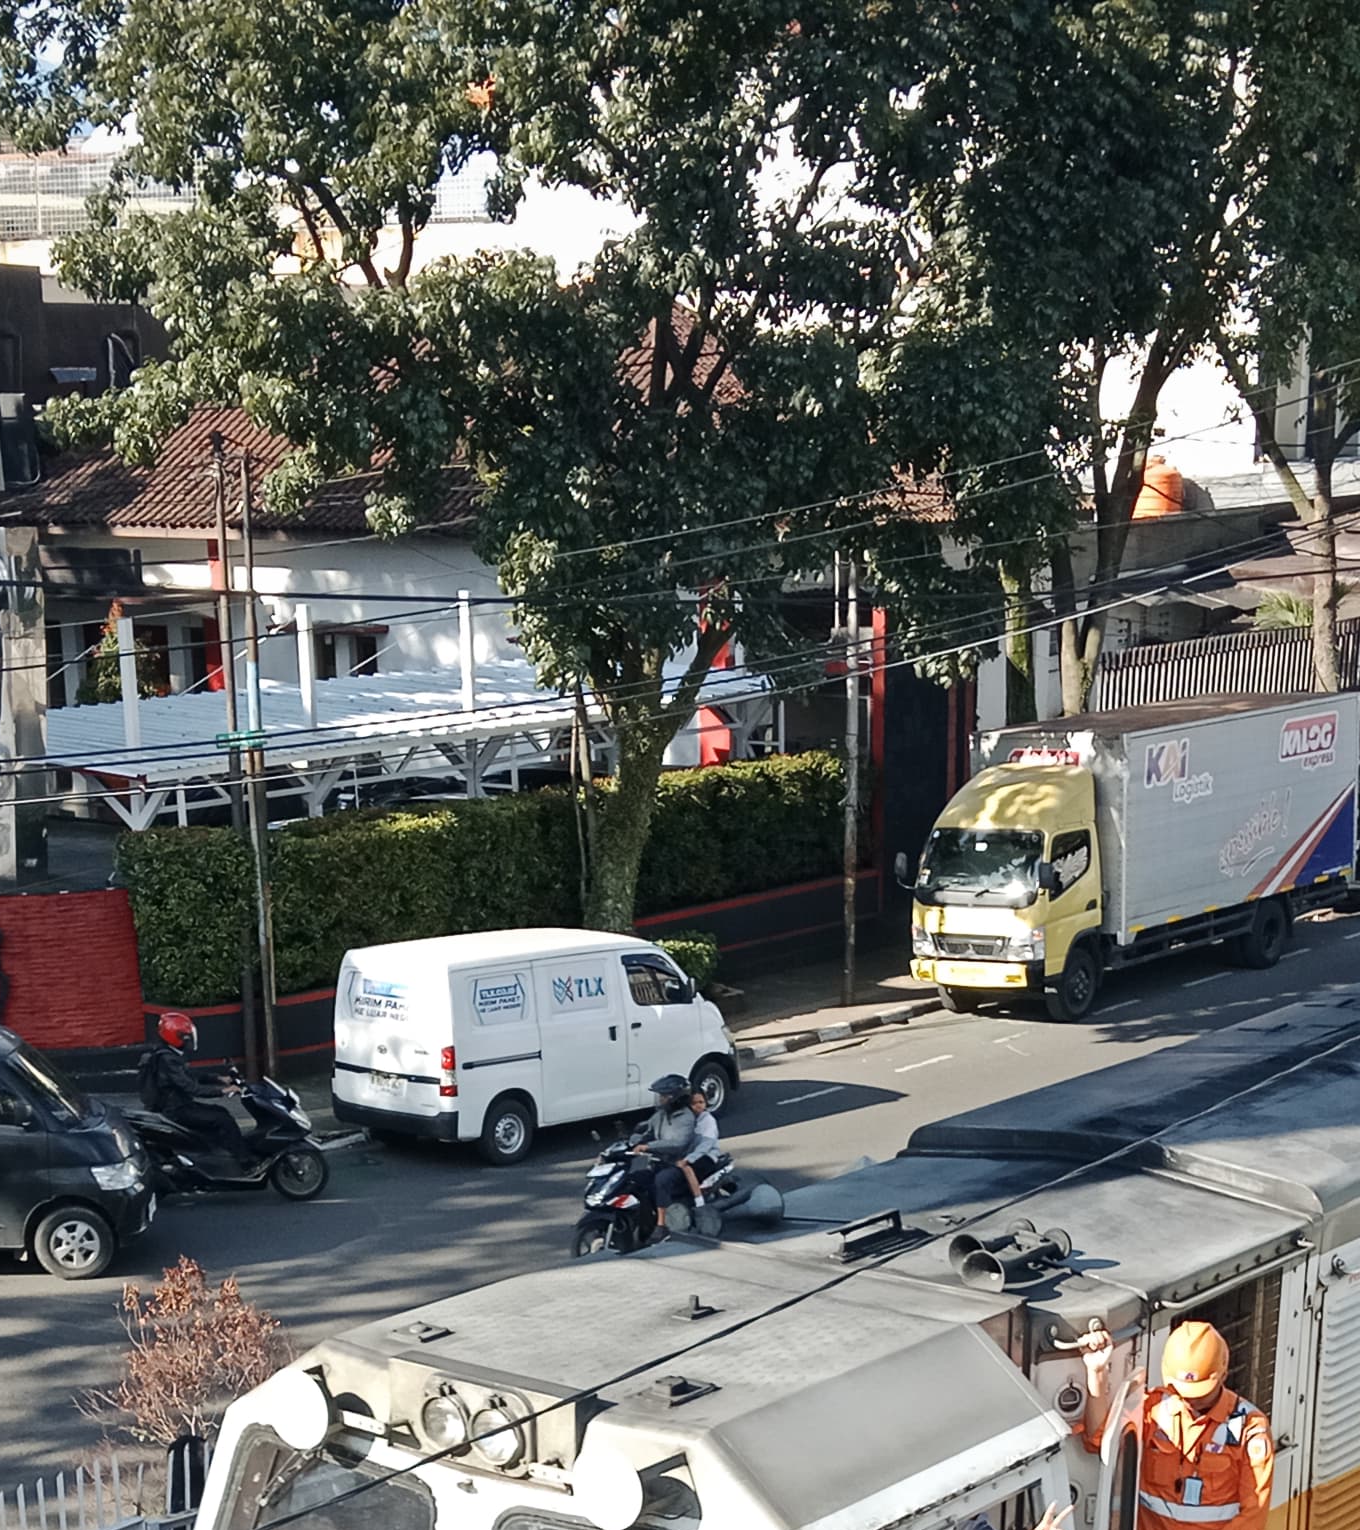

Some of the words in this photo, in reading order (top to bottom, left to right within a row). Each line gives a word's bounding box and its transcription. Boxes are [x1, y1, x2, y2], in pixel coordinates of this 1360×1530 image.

[1281, 721, 1333, 757] KALOG
[1146, 739, 1189, 787] KAI
[1303, 752, 1334, 769] express
[574, 976, 605, 998] TLX
